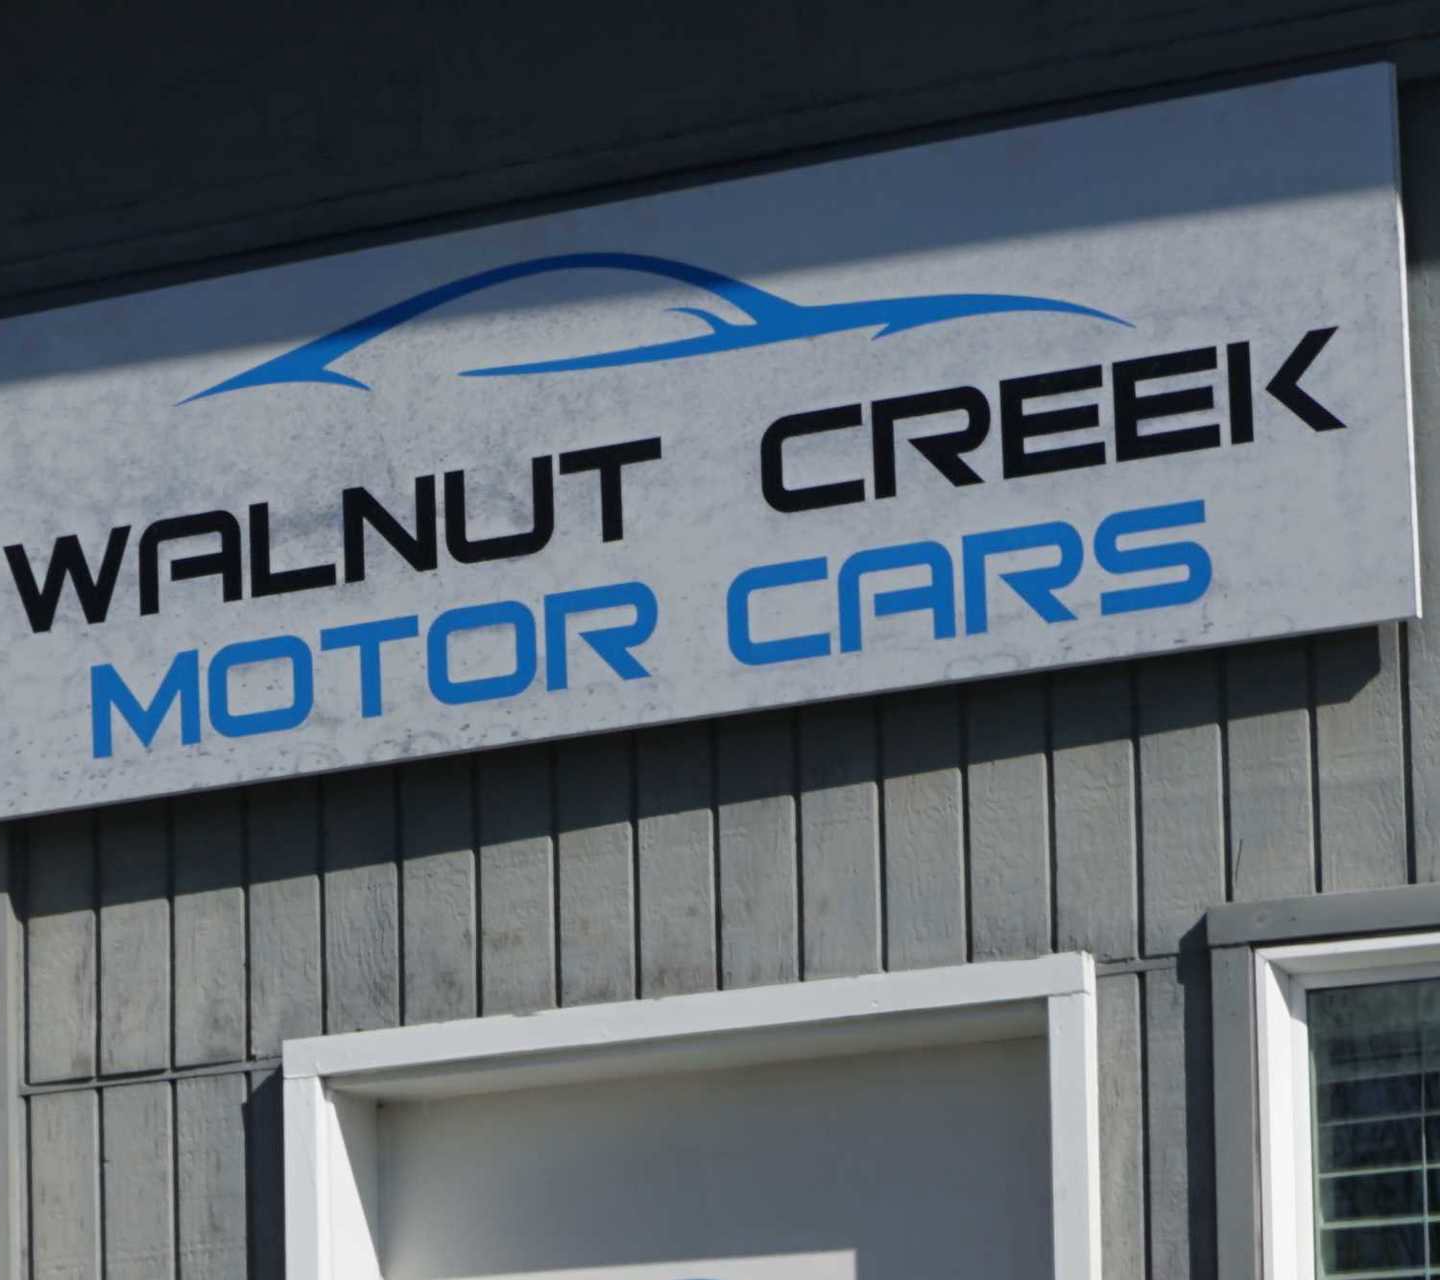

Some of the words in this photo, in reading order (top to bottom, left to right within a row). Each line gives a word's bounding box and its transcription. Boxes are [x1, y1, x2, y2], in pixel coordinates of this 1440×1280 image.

[4, 437, 661, 633] WALNUT
[760, 326, 1346, 513] CREEK
[90, 581, 659, 759] MOTOR
[726, 499, 1213, 667] CARS
